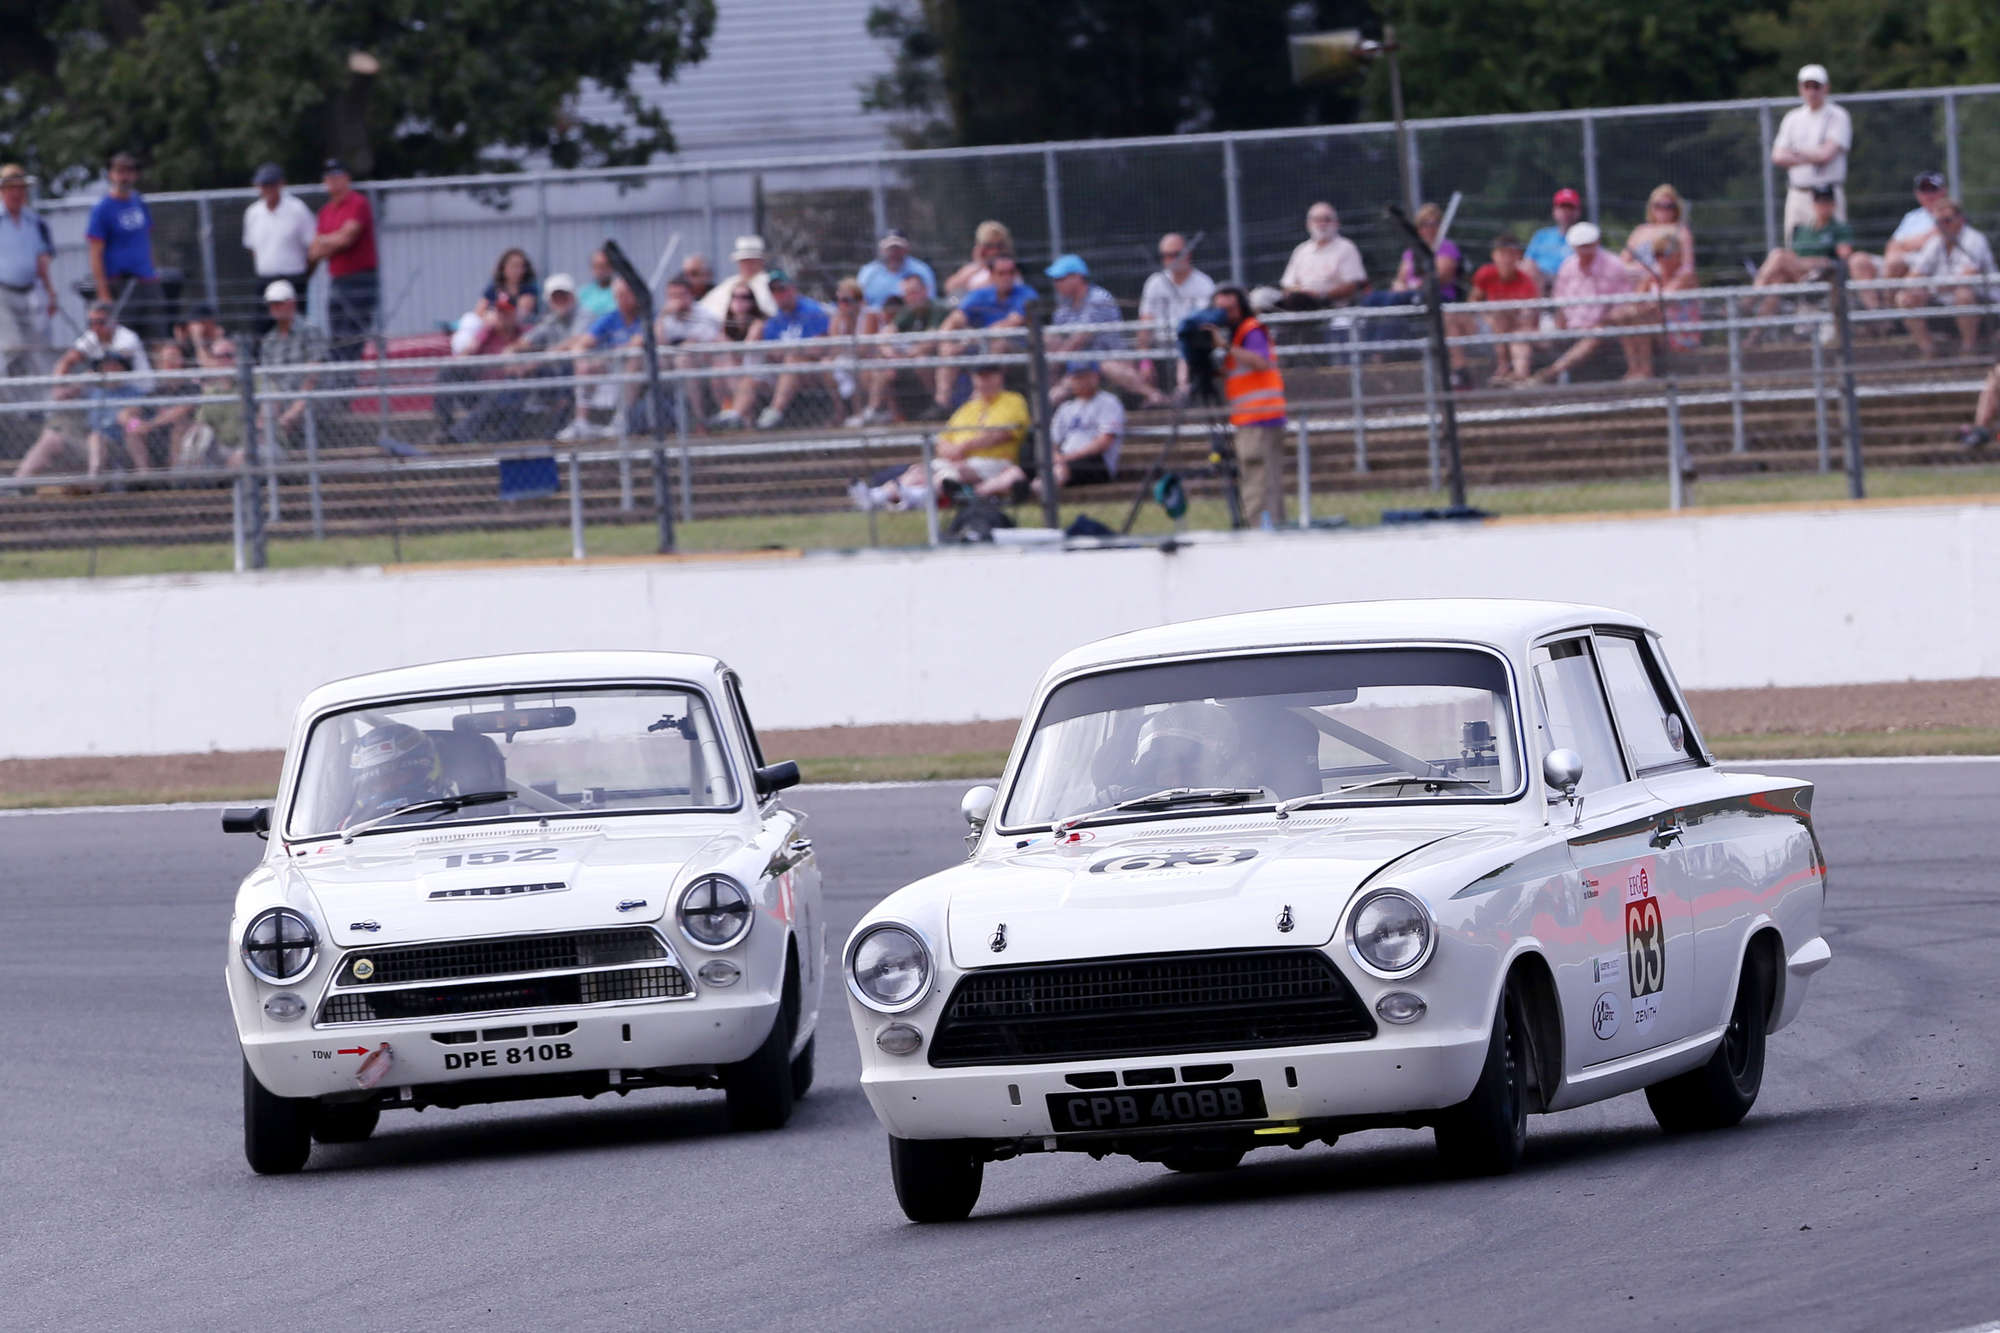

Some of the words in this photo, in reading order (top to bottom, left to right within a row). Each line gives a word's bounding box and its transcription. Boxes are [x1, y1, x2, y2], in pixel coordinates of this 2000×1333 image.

[440, 848, 559, 868] 152
[1104, 850, 1241, 873] 63
[446, 885, 551, 897] CONSUL
[1629, 902, 1661, 996] 63
[1634, 1007, 1657, 1024] ZENITH
[312, 1050, 332, 1059] TOW
[444, 1050, 498, 1070] DPE
[506, 1043, 574, 1064] 810B
[1067, 1096, 1139, 1127] CPB
[1151, 1087, 1244, 1120] 408B
